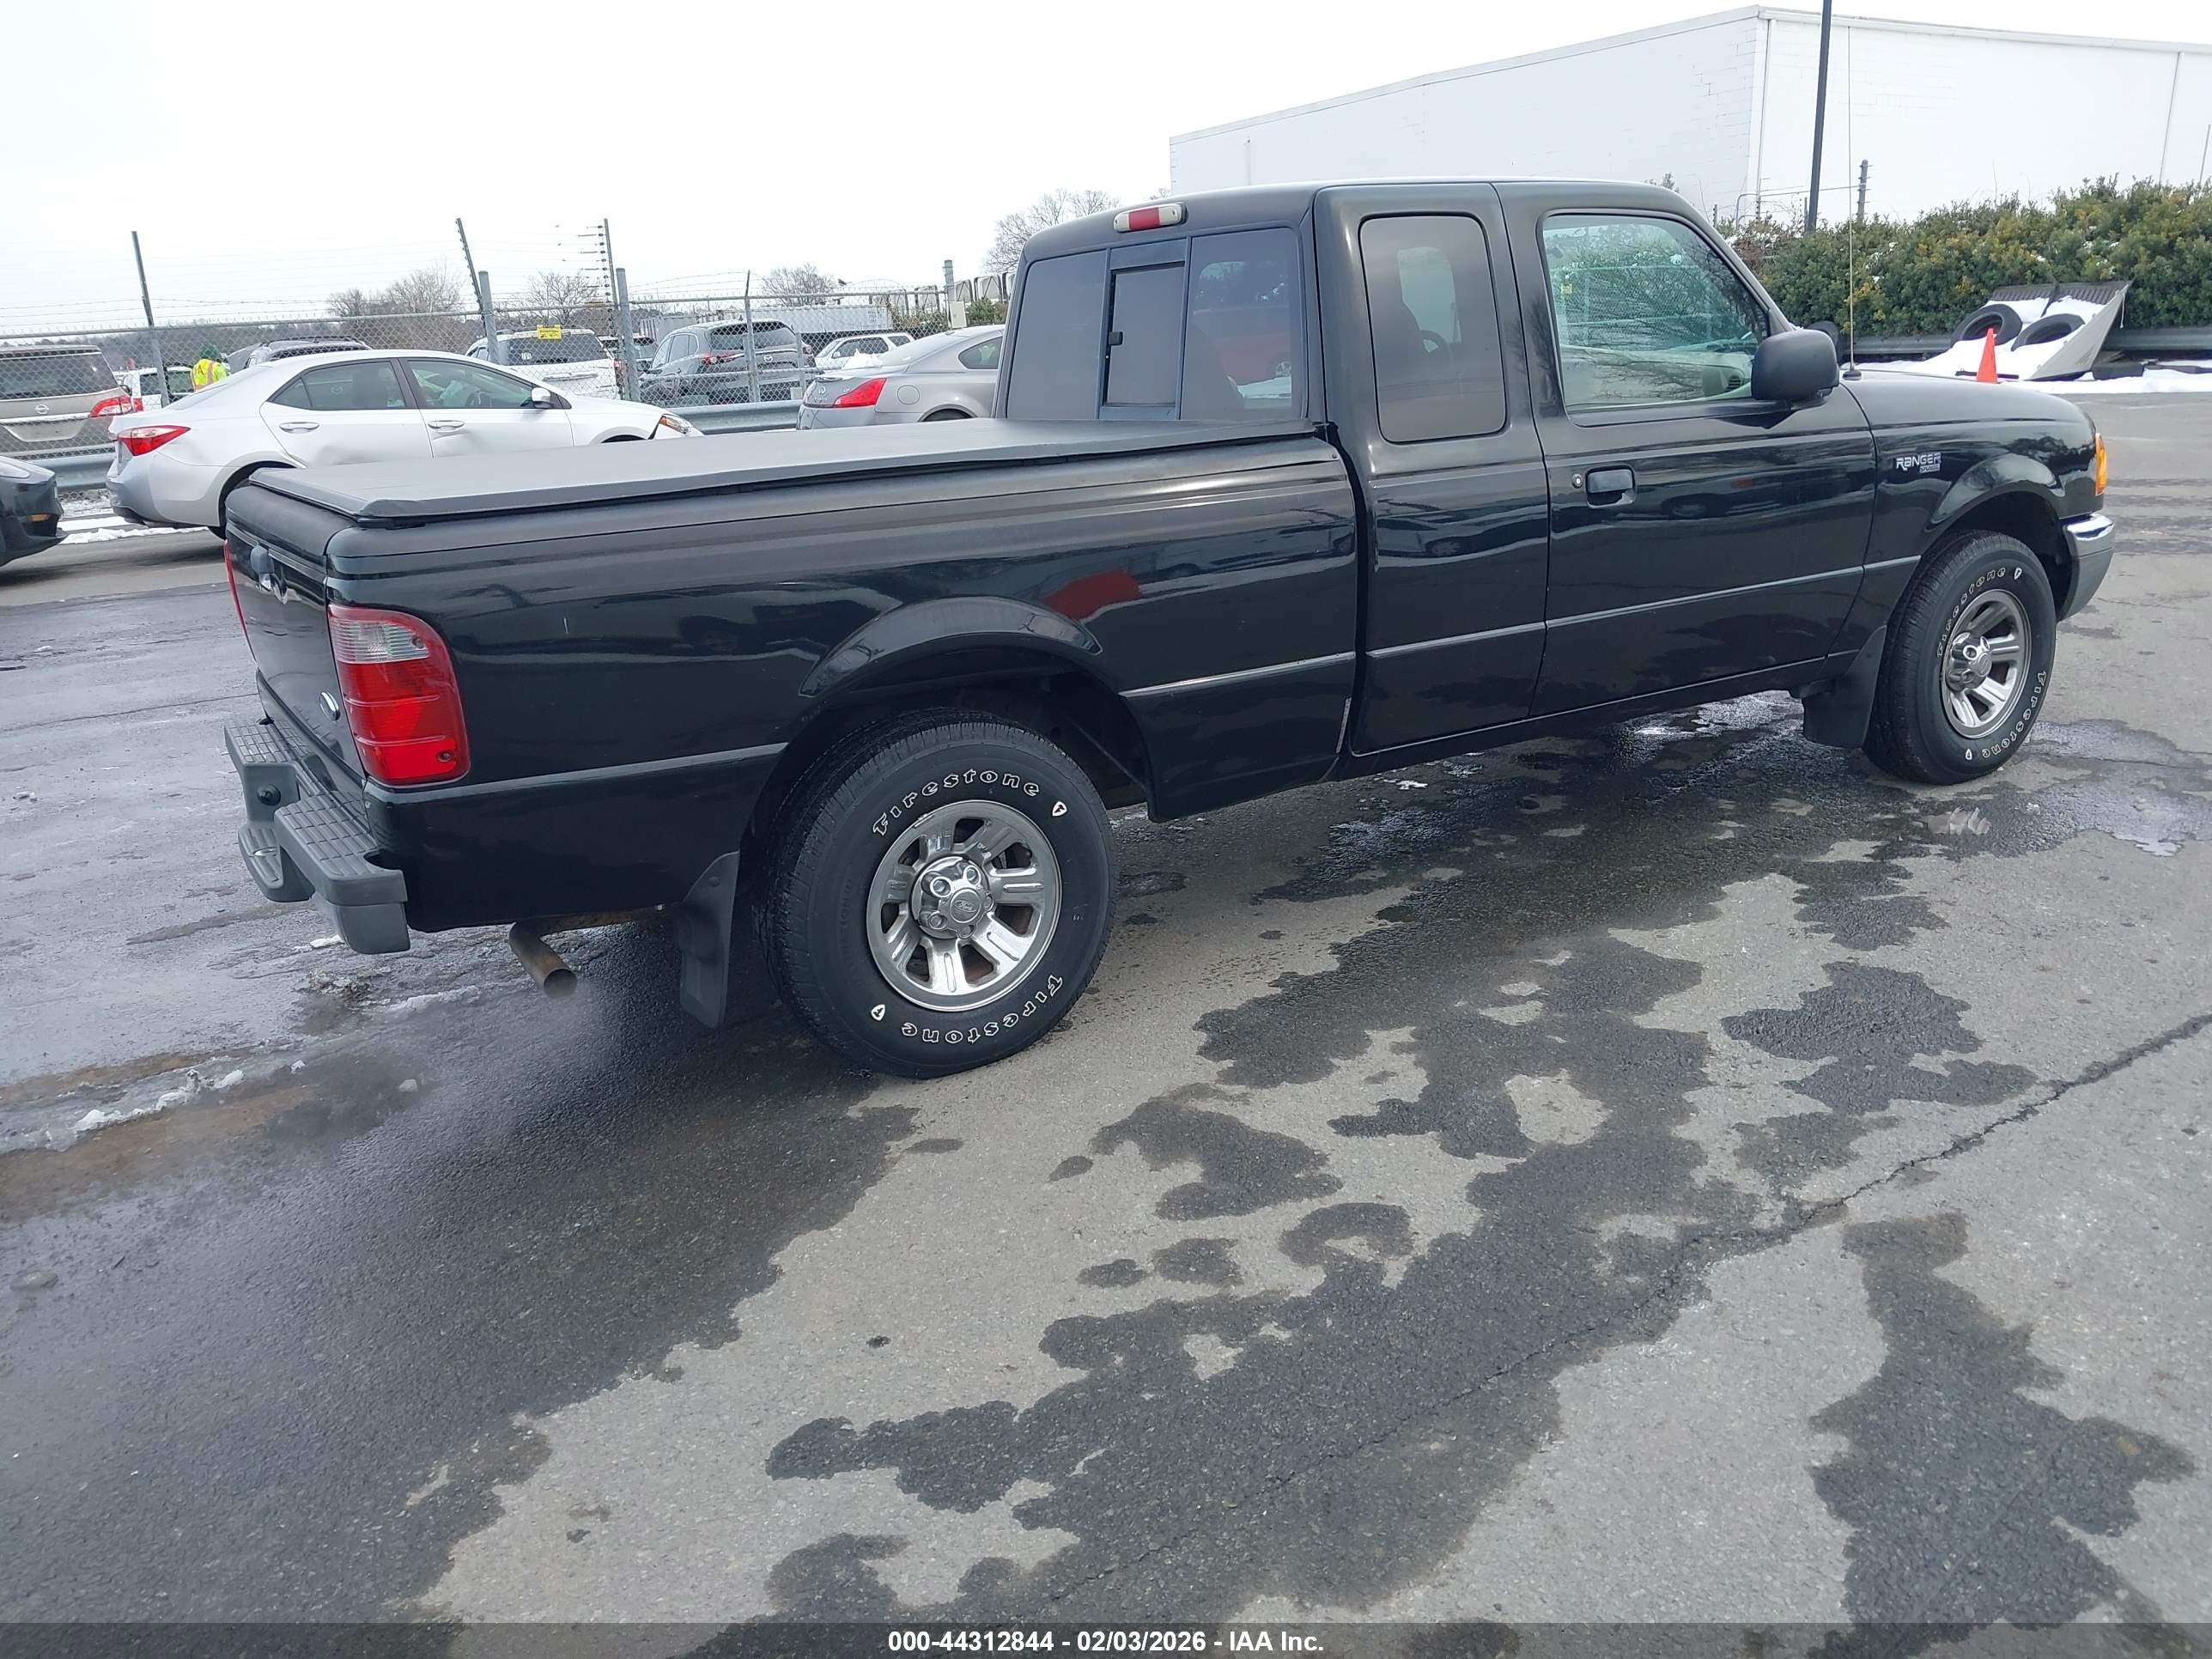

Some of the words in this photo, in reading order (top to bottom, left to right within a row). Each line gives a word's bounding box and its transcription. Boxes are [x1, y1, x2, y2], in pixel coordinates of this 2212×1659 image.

[1896, 453, 1942, 471] RANGER
[1981, 671, 2047, 759] Firestone
[872, 769, 1040, 836] Firestone
[902, 975, 1063, 1045] Firestone
